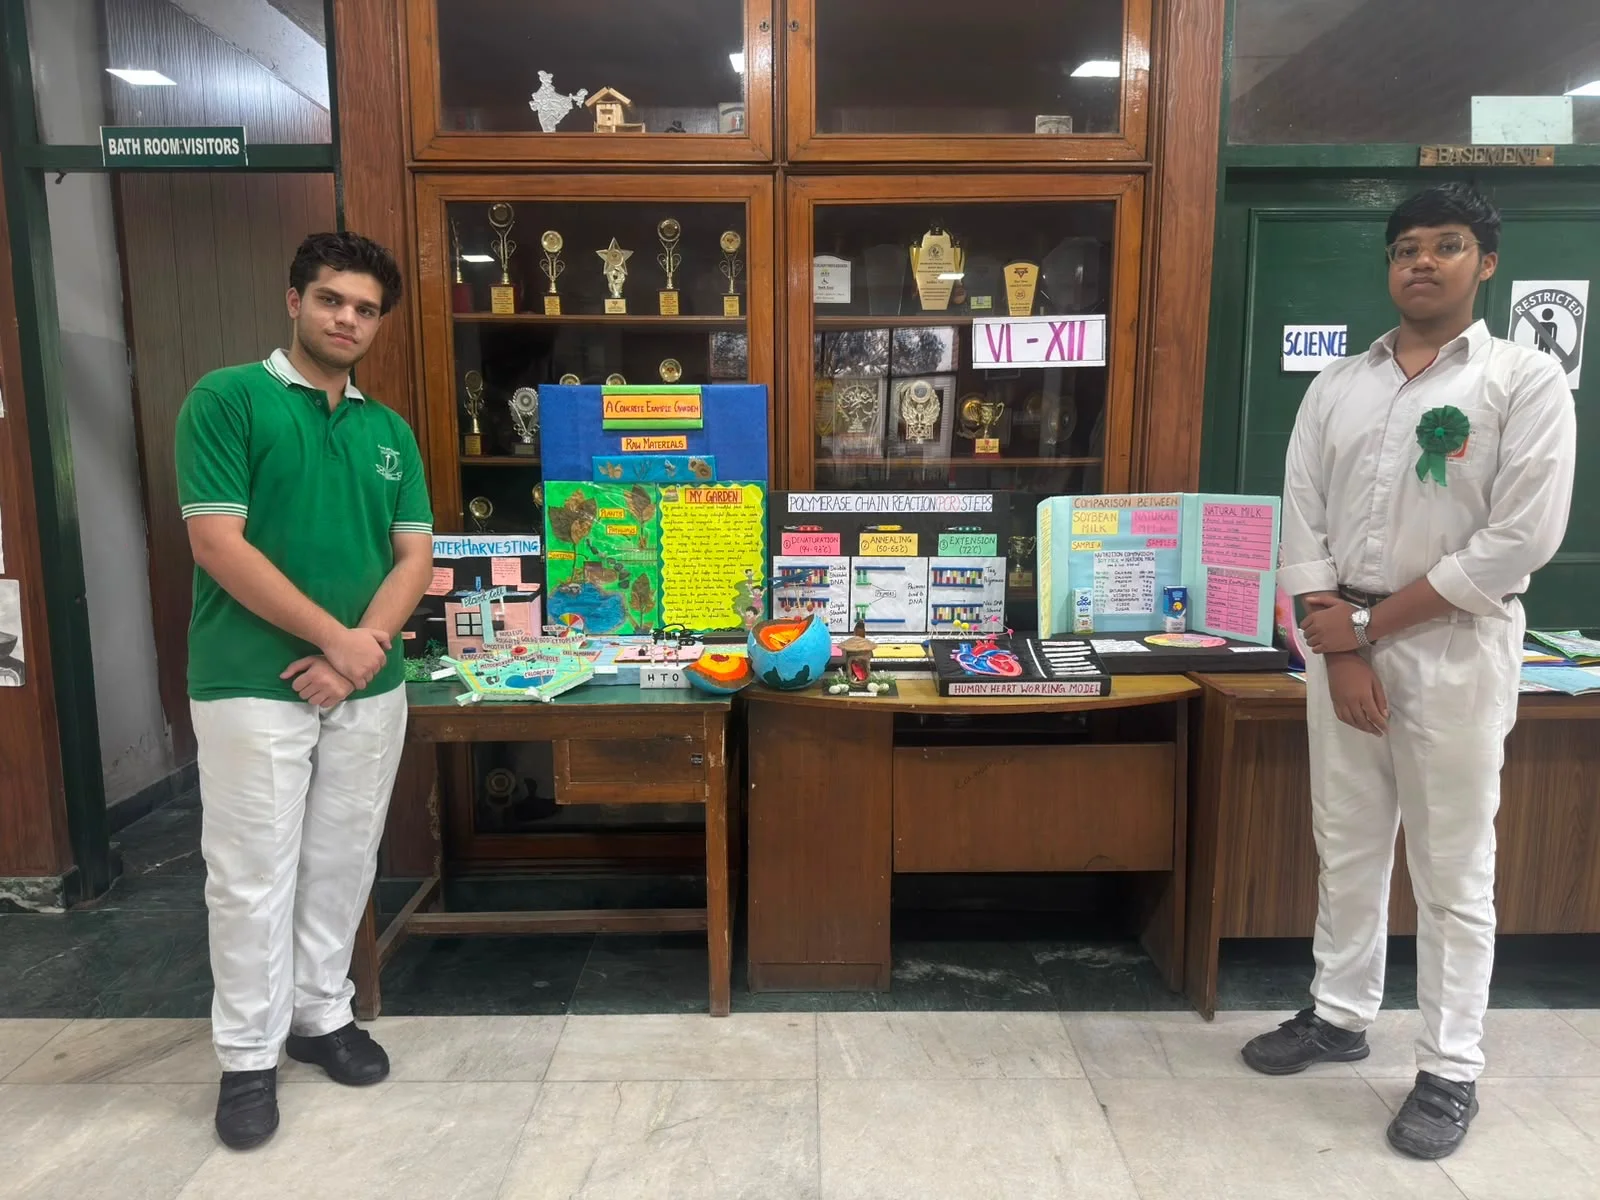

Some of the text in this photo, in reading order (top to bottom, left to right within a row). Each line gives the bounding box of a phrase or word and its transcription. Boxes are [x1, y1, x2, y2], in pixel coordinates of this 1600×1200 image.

[108, 138, 141, 155] BATH
[1436, 145, 1539, 165] BASEMENT
[1514, 292, 1583, 317] RESTRICTED
[1045, 320, 1086, 361] XII
[1283, 331, 1347, 357] SCIENCE
[605, 401, 614, 412] A
[643, 437, 684, 449] MATERIALS
[690, 491, 738, 503] MY GARDEN
[789, 496, 852, 511] POLYMERASE
[855, 496, 889, 511] CHAIN
[892, 496, 936, 511] REACTION
[960, 496, 992, 511] STEPS
[1074, 498, 1178, 509] COMPARISON BETWEEN
[1073, 512, 1117, 522] SOYBEAN
[1135, 512, 1175, 521] NATURAL
[1204, 506, 1262, 518] NATURAL MILK
[1082, 524, 1107, 533] MILK
[950, 536, 996, 544] EXTENSION
[433, 538, 538, 556] ATER HARVESTING
[660, 673, 668, 682] T
[954, 684, 1100, 694] HUMAN HEART WORKING MODEL
